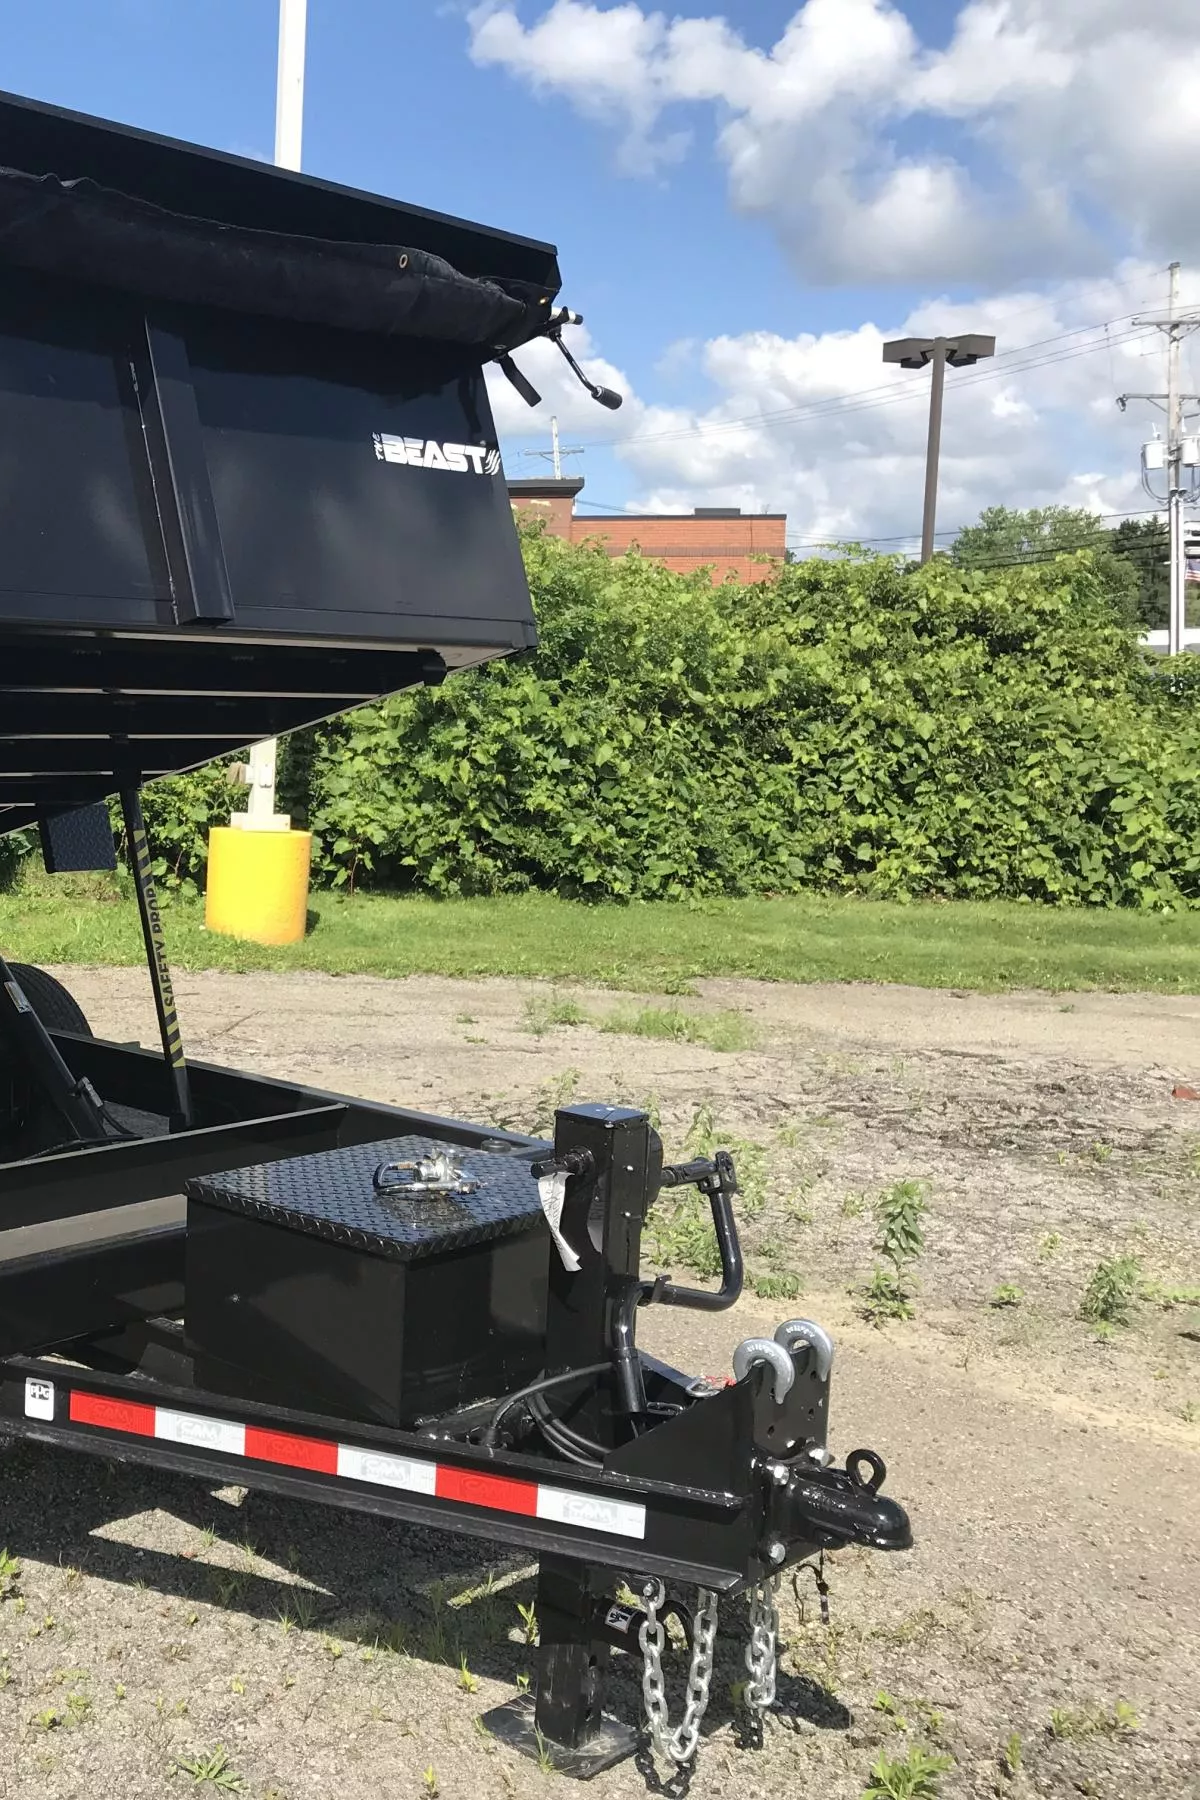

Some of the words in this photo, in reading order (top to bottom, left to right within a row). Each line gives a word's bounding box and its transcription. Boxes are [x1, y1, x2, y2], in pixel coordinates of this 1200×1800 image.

[380, 433, 487, 474] BEAST
[146, 888, 162, 934] PROP
[155, 940, 175, 1007] SAFETY
[30, 1384, 51, 1400] PPG
[181, 1421, 218, 1442] CAM
[365, 1459, 406, 1482] CAM
[568, 1499, 612, 1523] CAM
